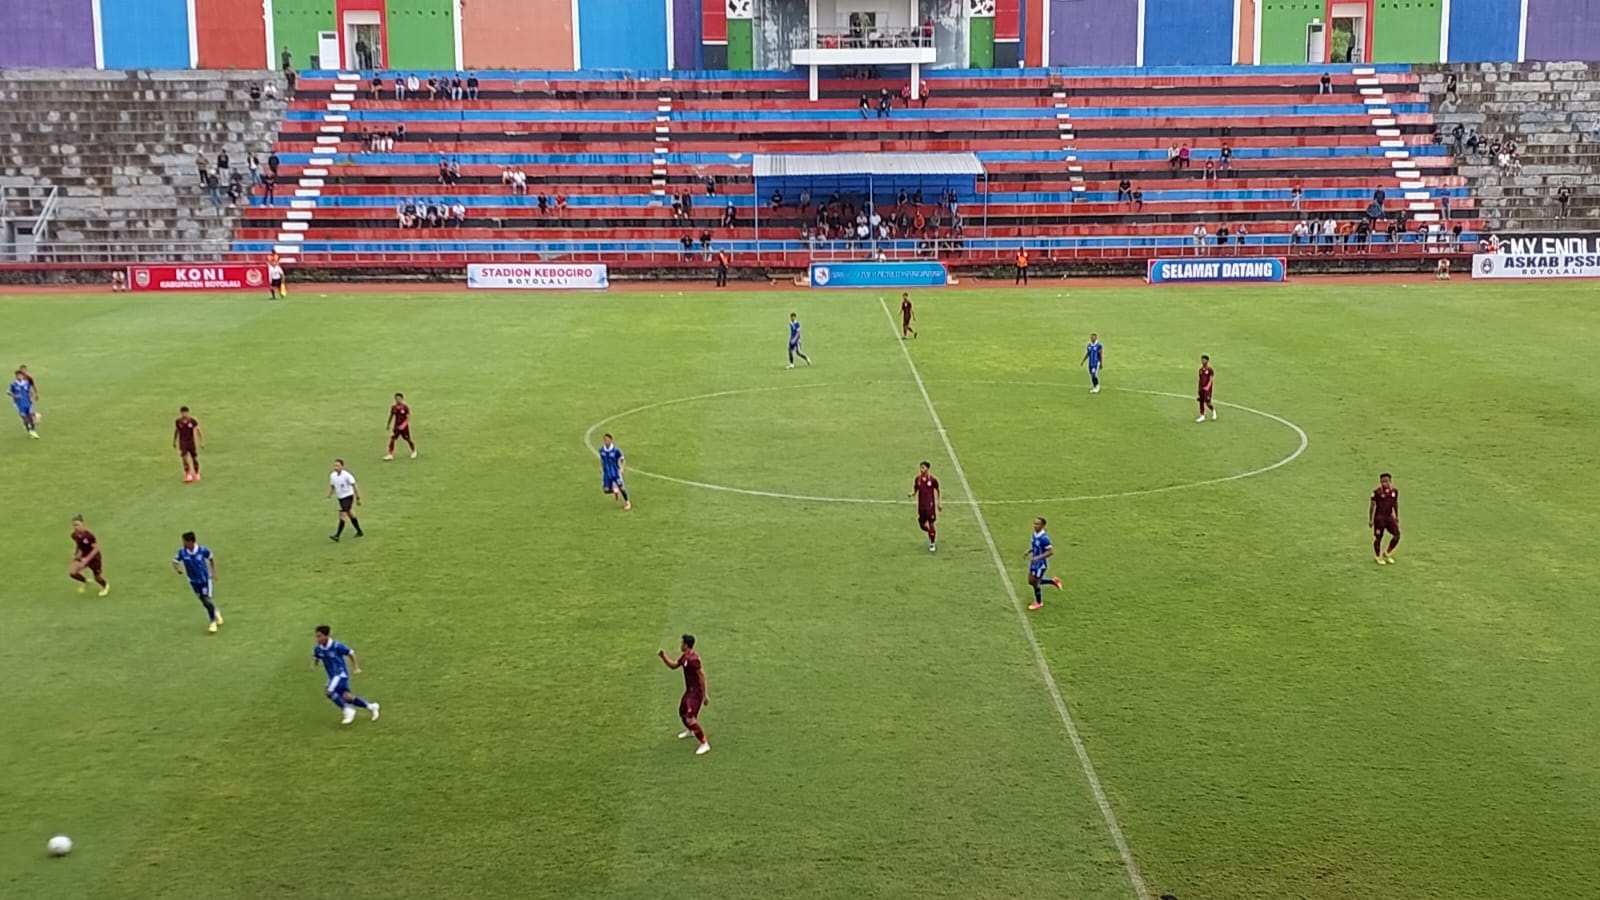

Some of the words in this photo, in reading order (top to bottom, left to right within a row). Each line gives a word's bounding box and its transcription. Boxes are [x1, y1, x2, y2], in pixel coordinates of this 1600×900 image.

[1510, 238, 1537, 254] MY
[1504, 256, 1559, 268] ASKAB
[175, 268, 224, 280] KONI
[481, 268, 531, 277] STADION
[534, 268, 593, 277] KEBOGIRO
[1162, 263, 1220, 278] SELAMAT
[1222, 263, 1273, 277] DATANG
